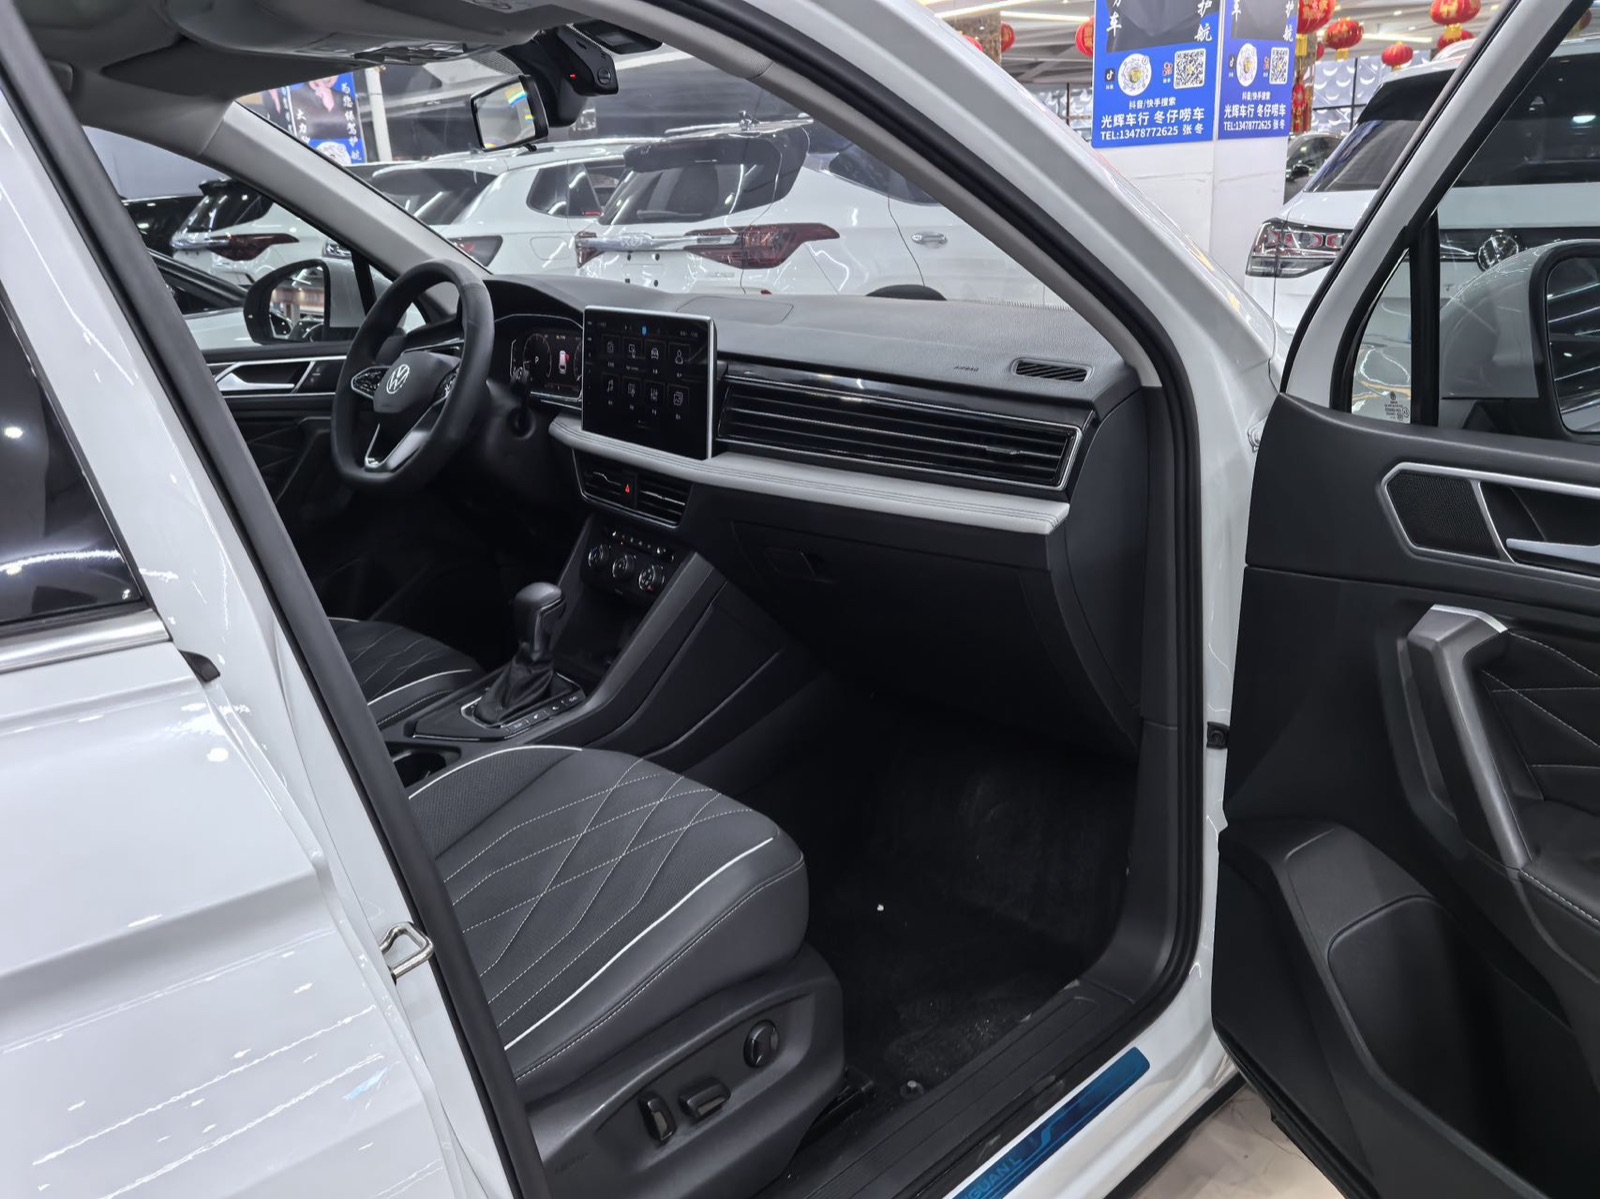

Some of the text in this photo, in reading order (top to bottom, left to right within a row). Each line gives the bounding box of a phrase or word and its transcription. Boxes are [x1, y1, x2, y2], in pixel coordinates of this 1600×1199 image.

[1101, 107, 1205, 129] 光辉车行 冬仔唠车
[1101, 126, 1178, 140] TEL:13478772625
